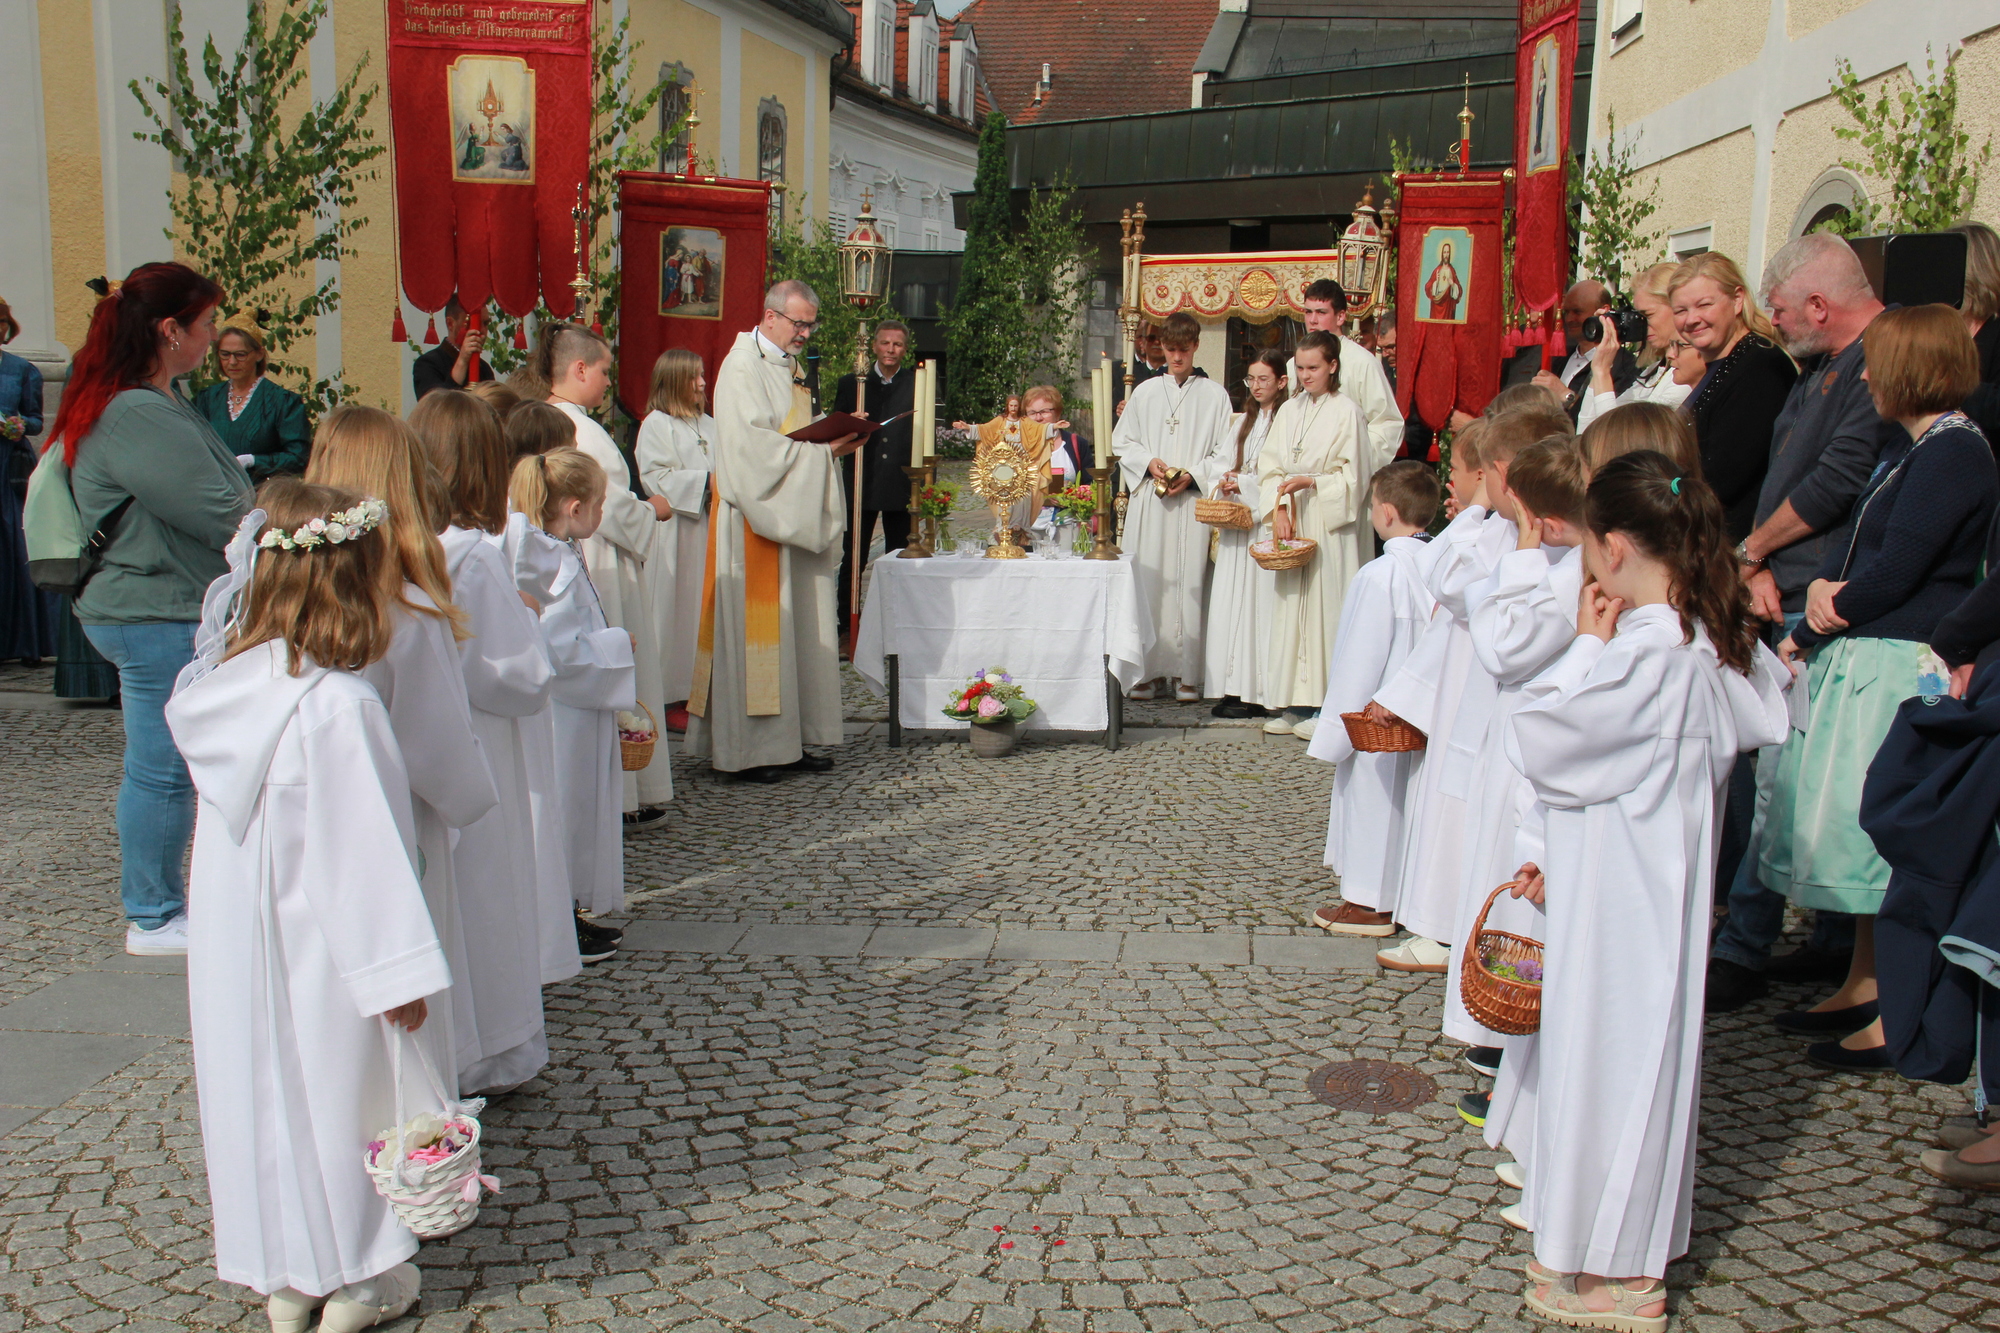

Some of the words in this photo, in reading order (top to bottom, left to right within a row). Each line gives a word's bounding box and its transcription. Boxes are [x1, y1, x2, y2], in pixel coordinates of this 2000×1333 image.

[473, 6, 493, 18] und
[499, 7, 555, 23] gebenedeit
[560, 10, 576, 23] sei
[405, 19, 424, 32] das
[428, 20, 472, 38] heiligste
